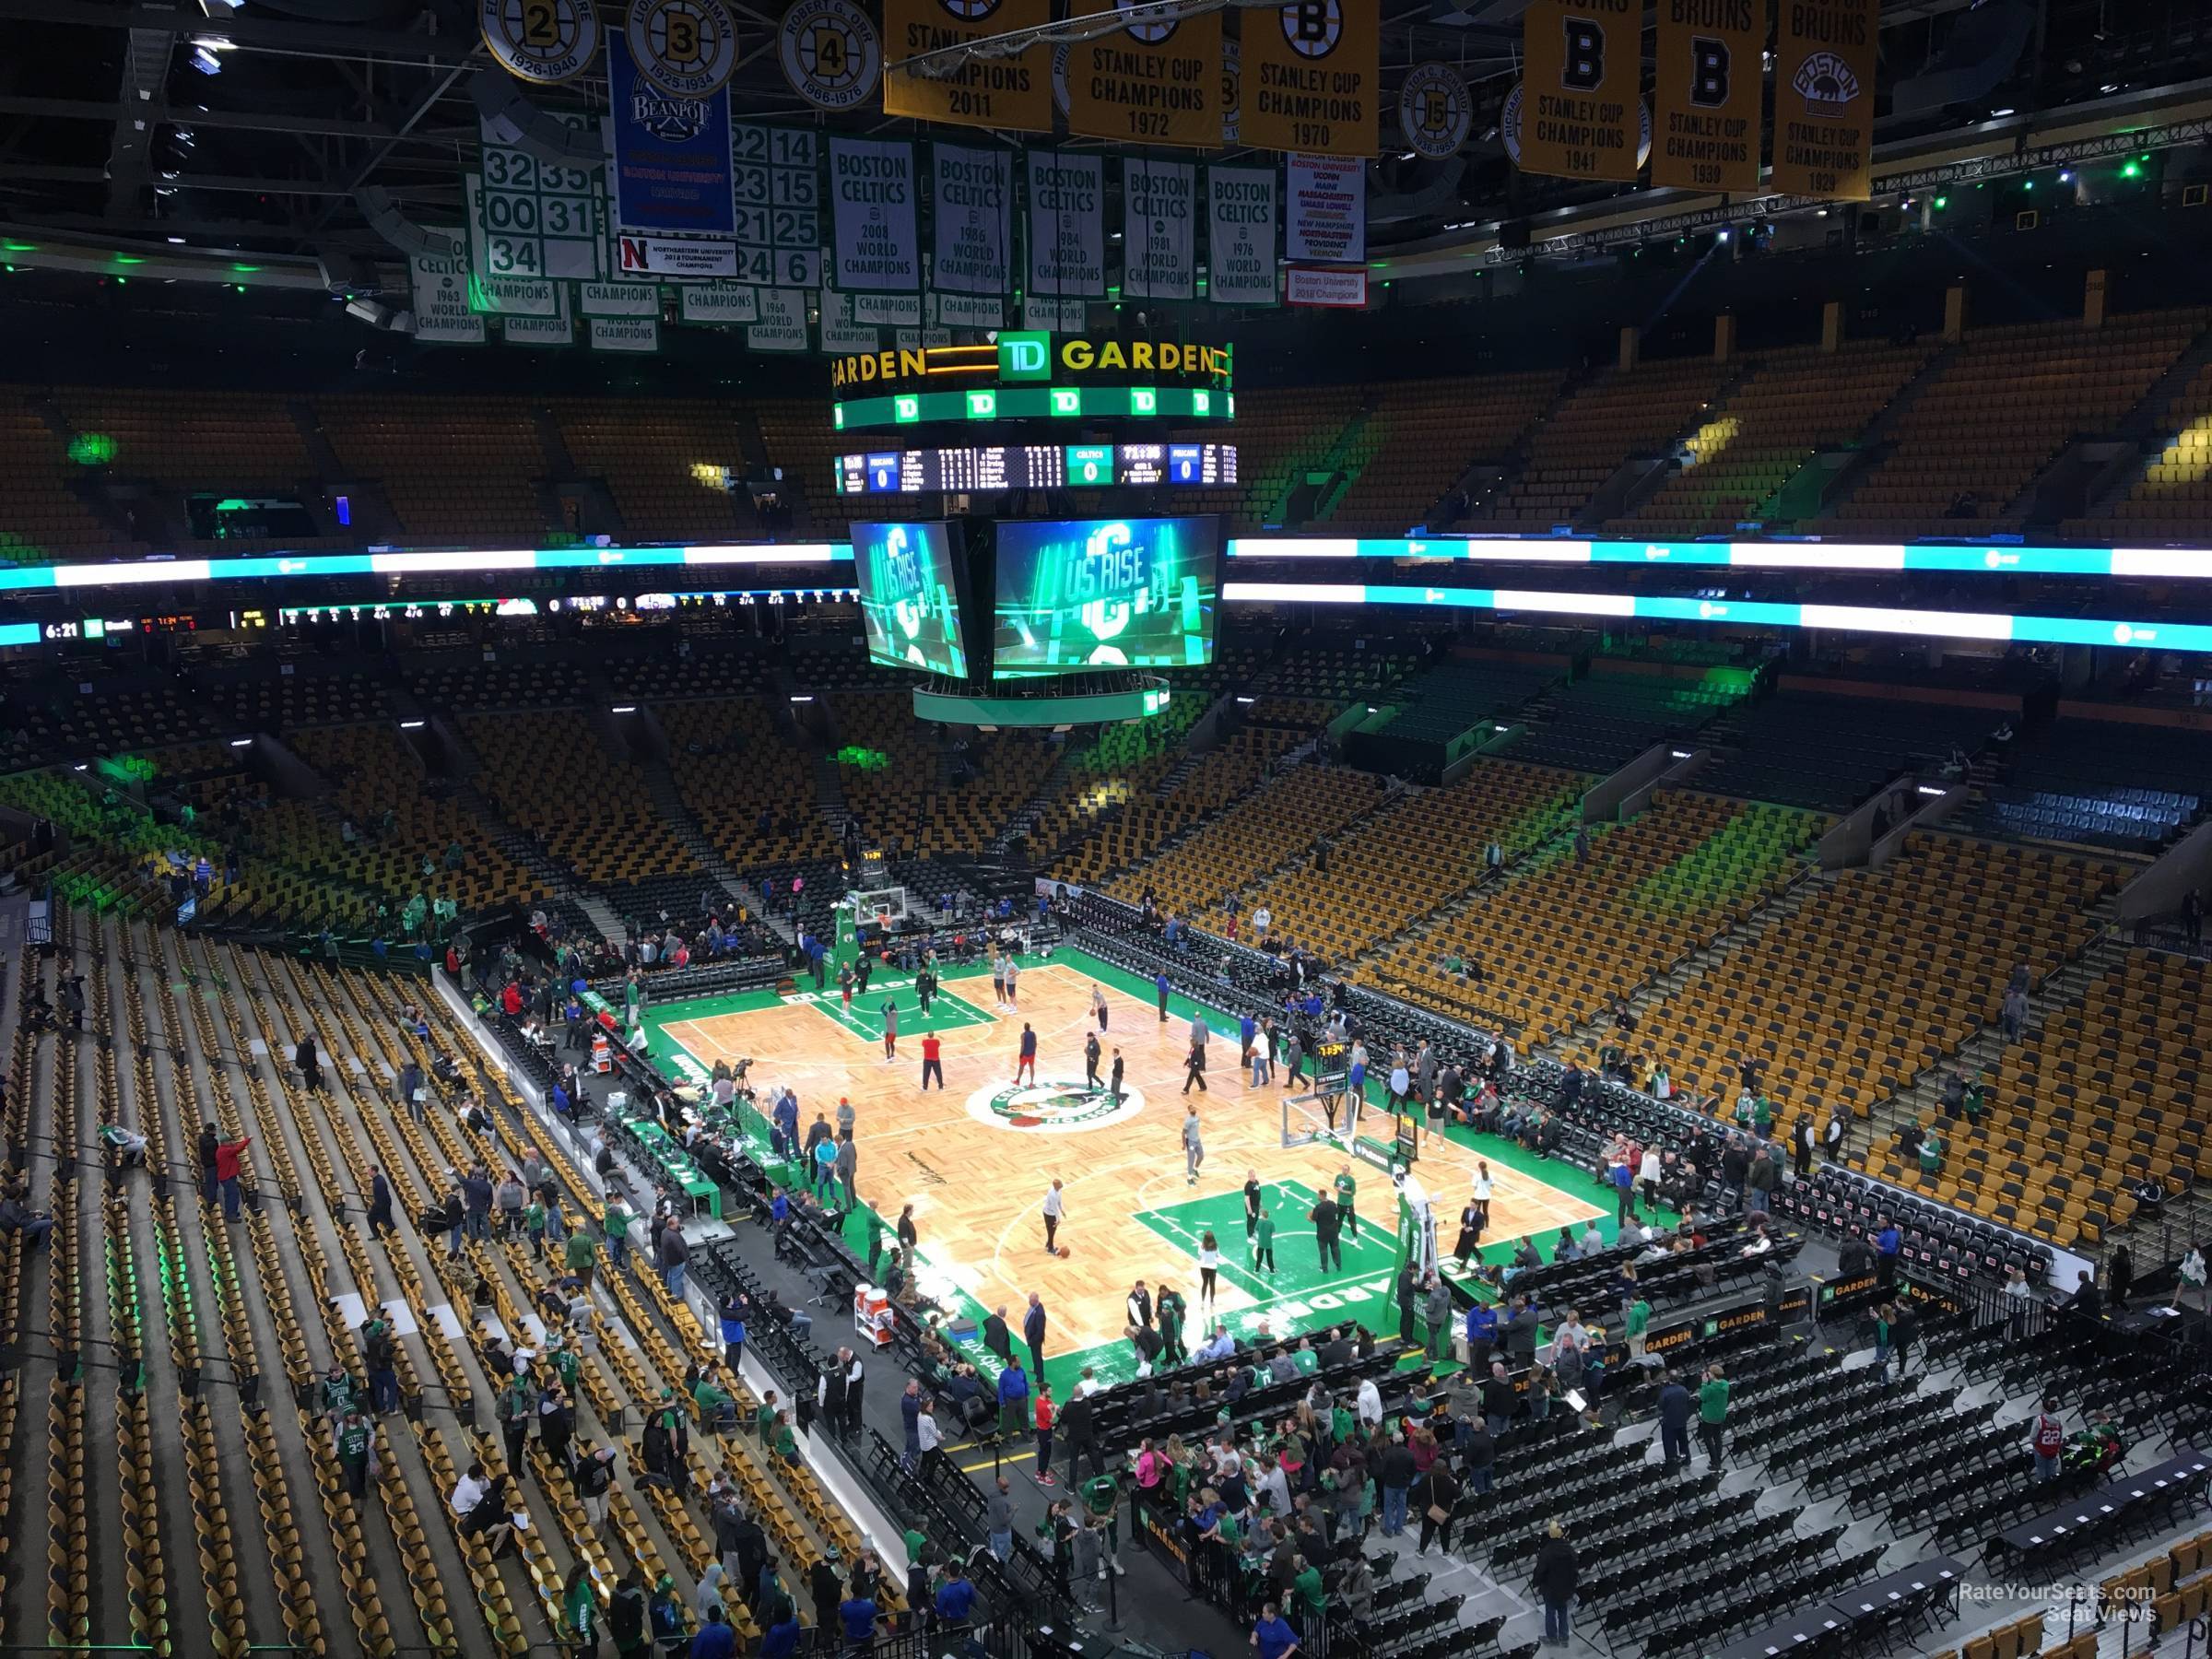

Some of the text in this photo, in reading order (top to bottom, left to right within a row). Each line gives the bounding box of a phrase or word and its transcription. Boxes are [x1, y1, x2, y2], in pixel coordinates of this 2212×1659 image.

[526, 5, 552, 38] 2
[786, 0, 829, 35] ROBERT
[851, 15, 873, 43] ORR
[1792, 5, 1866, 45] BRUINS
[671, 22, 692, 53] 3
[820, 39, 841, 68] 4
[1561, 15, 1606, 92] B
[510, 53, 578, 76] 1926-1940
[1093, 47, 1203, 82] STANLEY CUP
[1689, 35, 1731, 109] B
[1795, 53, 1858, 97] BOSTON
[650, 64, 714, 90] 1925-1934
[1260, 62, 1360, 94] STANLEY CUP
[802, 80, 862, 103] 1966-1976
[1090, 76, 1204, 111] CHAMPIONS
[632, 94, 710, 130] BEANPOT
[949, 90, 992, 117] 2011
[1259, 90, 1362, 122] CHAMPIONS
[1428, 100, 1444, 124] 15
[1539, 95, 1623, 124] STANLEY CUP
[1128, 110, 1169, 135] 1972
[1669, 112, 1747, 137] STANLEY CUP
[1293, 122, 1330, 146] 1970
[1537, 121, 1624, 148] CHAMPIONS
[1788, 123, 1860, 147] STANLEY CUP
[776, 133, 811, 163] 14
[1667, 137, 1747, 161] CHAMPIONS
[1786, 145, 1860, 170] CHAMPIONS
[488, 152, 532, 185] 32
[838, 153, 906, 179] BOSTON
[1291, 160, 1321, 170] BOSTON
[1566, 150, 1595, 171] 1941
[940, 159, 1006, 186] BOSTON
[1035, 167, 1096, 189] BOSTON
[1692, 163, 1721, 184] 1939
[1808, 172, 1836, 191] 1929
[777, 171, 813, 203] 15
[841, 180, 906, 204] CELTICS
[943, 182, 1002, 207] CELTICS
[1130, 173, 1189, 197] BOSTON
[1215, 182, 1270, 202] BOSTON
[1038, 190, 1094, 212] CELTICS
[1133, 196, 1187, 219] CELTICS
[488, 196, 535, 229] 00
[548, 201, 587, 232] 31
[1218, 204, 1268, 223] CELTICS
[776, 213, 817, 244] 25
[862, 225, 888, 239] 2008
[960, 226, 985, 242] 1986
[622, 238, 649, 270] N
[856, 241, 898, 257] WORLD
[953, 242, 994, 261] WORLD
[1150, 236, 1170, 252] 1981
[1233, 242, 1253, 256] 1976
[1304, 239, 1347, 249] PROVIDENCE
[493, 240, 536, 272] 34
[1050, 249, 1087, 264] WORLD
[1141, 253, 1178, 267] WORLD
[1227, 259, 1261, 273] WORLD
[788, 253, 807, 283] 6
[844, 259, 911, 275] CHAMPIONS
[940, 259, 1006, 279] CHAMPIONS
[1038, 265, 1100, 281] CHAMPIONS
[1128, 268, 1189, 285] CHAMPIONS
[480, 282, 549, 300] CHAMPIONS
[1215, 276, 1271, 288] CHAMPIONS
[1295, 275, 1359, 288] Boston University
[437, 290, 459, 301] 1963
[586, 286, 653, 301] CHAMPIONS
[688, 292, 752, 309] CHAMPIONS
[1316, 289, 1359, 302] Champions
[430, 303, 467, 316] WORLD
[766, 302, 786, 313] 1960
[859, 297, 918, 312] CHAMPIONS
[945, 300, 1000, 315] CHAMPIONS
[418, 316, 480, 331] CHAMPIONS
[509, 318, 567, 332] CHAMPIONS
[761, 316, 793, 327] WORLD
[595, 325, 653, 340] CHAMPIONS
[751, 327, 804, 340] CHAMPIONS
[826, 330, 875, 342] CHAMPIONS
[1003, 340, 1215, 372] TD GARDEN
[832, 347, 926, 387] GARDEN
[896, 398, 917, 418] TD
[969, 394, 994, 414] TD
[1053, 392, 1078, 412] TD
[1133, 392, 1155, 411] TD
[1077, 450, 1104, 459] CELTICS
[877, 469, 888, 488] 0
[1084, 462, 1098, 481] 0
[1182, 461, 1191, 479] 0
[898, 550, 920, 593] RISE
[1065, 546, 1145, 601] US RISE
[45, 622, 77, 638] 6:21
[104, 619, 133, 630] Bank
[1326, 1073, 1346, 1081] TISSOT
[1361, 1146, 1389, 1167] Putnam
[1835, 1276, 1877, 1296] GARDEN
[1779, 1299, 1806, 1311] GARDEN
[1719, 1311, 1766, 1330] GARDEN
[1646, 1330, 1692, 1353] GARDEN
[349, 1441, 364, 1454] 33
[2041, 1430, 2060, 1445] 22
[1148, 1520, 1187, 1564] GARDEN
